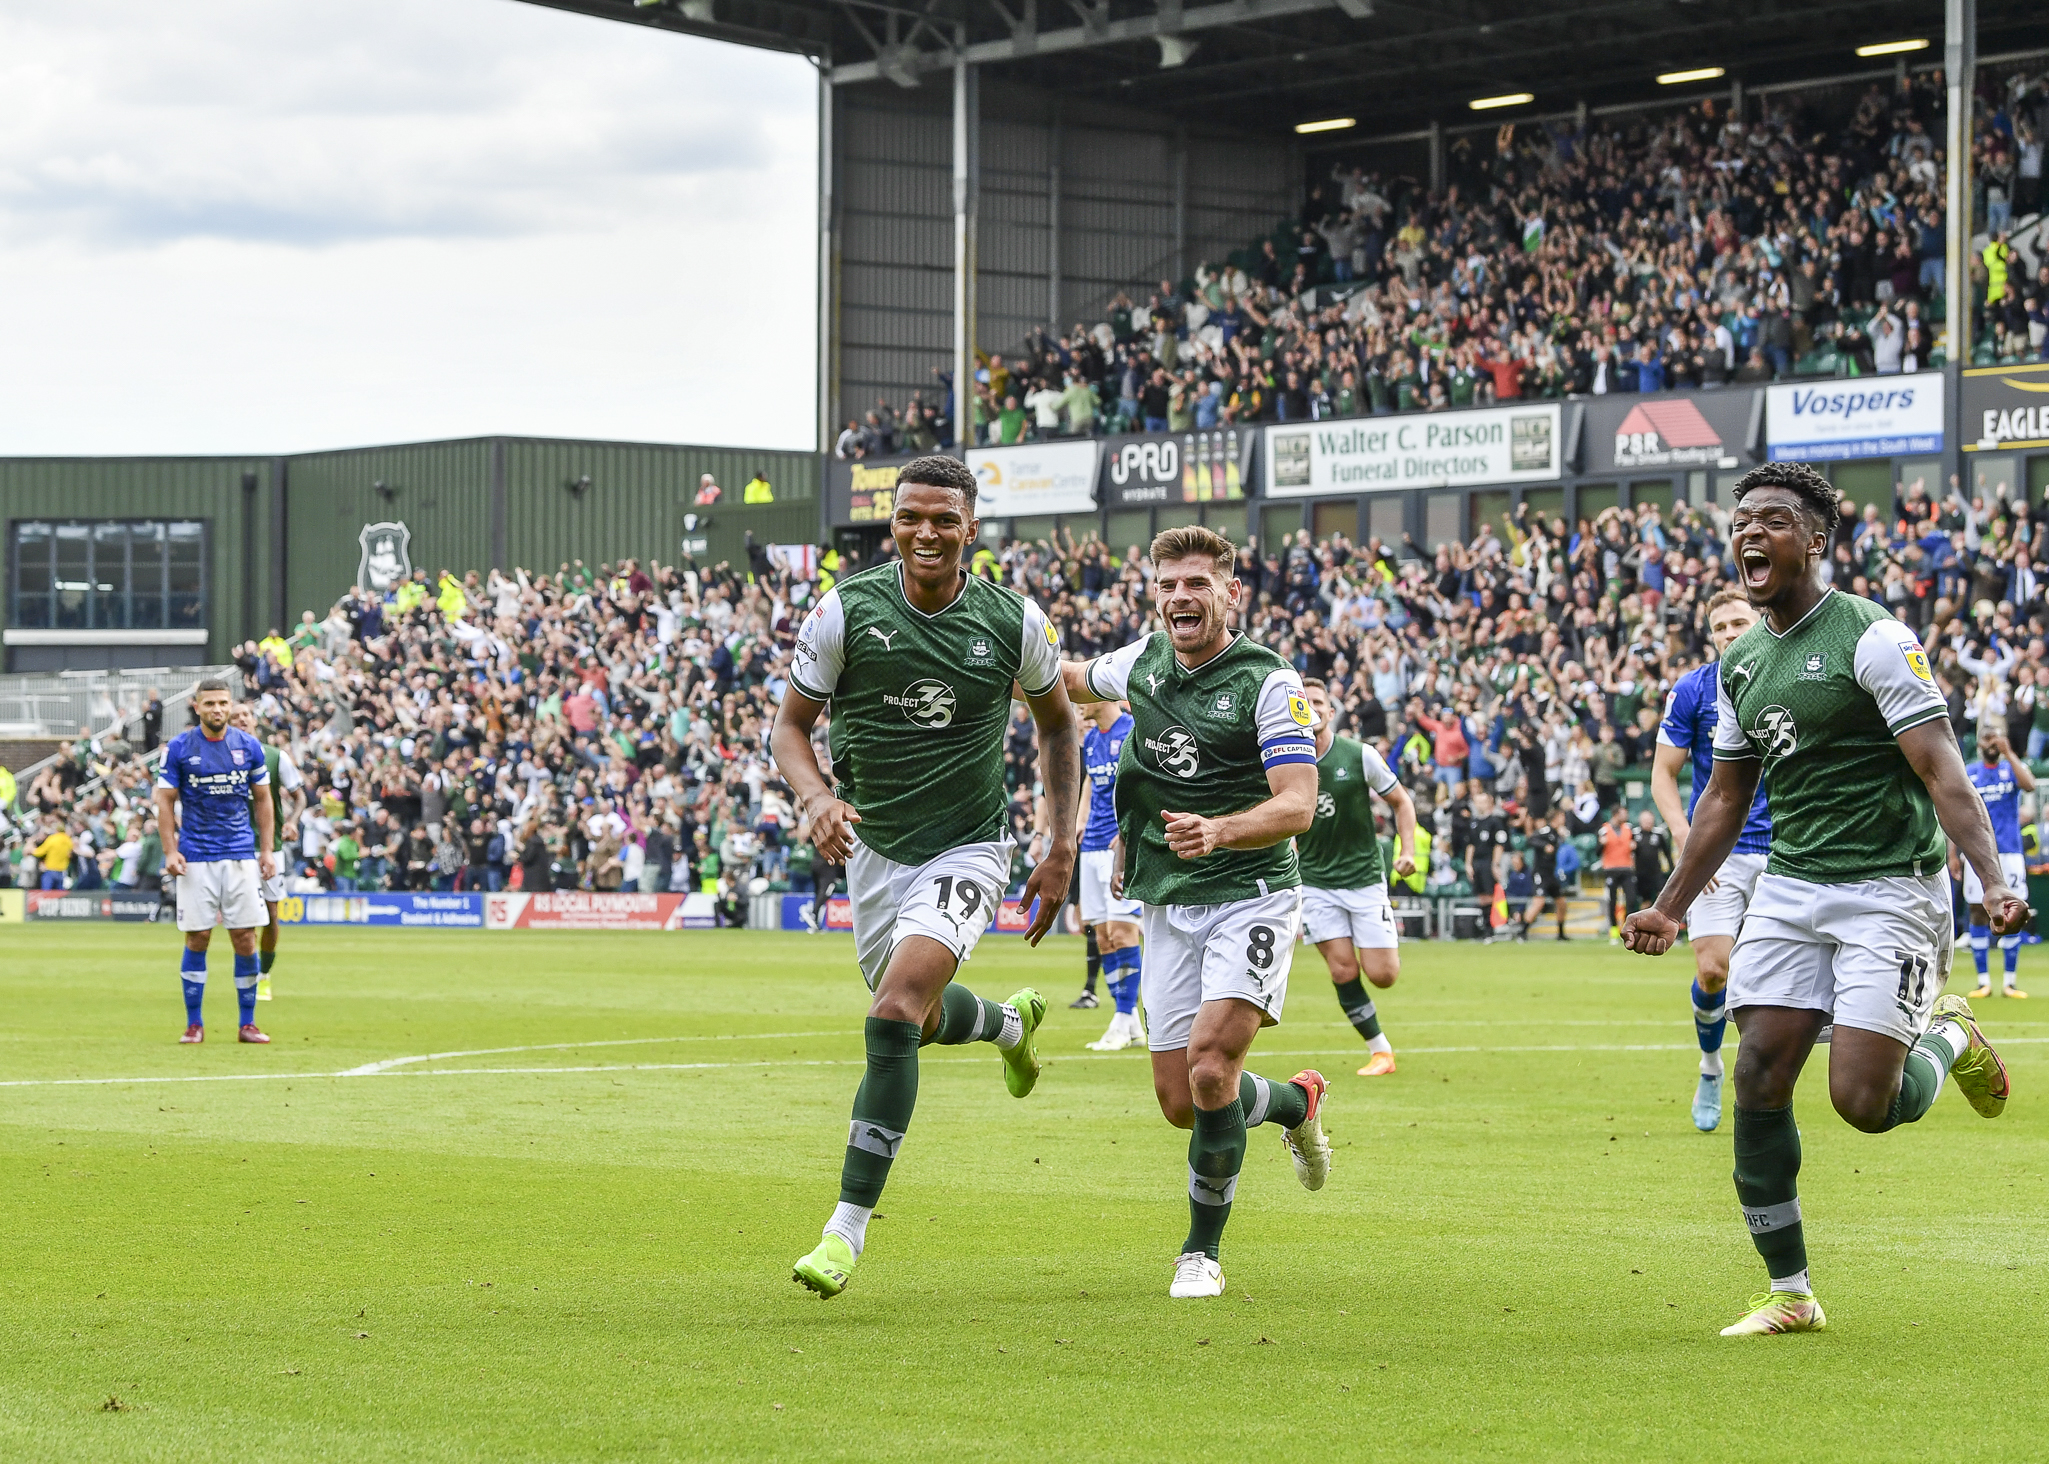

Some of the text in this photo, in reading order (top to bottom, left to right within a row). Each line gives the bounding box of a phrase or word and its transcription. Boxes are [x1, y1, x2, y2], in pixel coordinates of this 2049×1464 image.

[1793, 388, 1915, 418] Vospers
[1318, 421, 1503, 455] Walter C. Parson
[1983, 405, 2049, 441] EAGLE
[1615, 431, 1659, 455] PSR
[1332, 454, 1489, 484] Funeral Directors
[883, 694, 920, 708] PROJECT
[1145, 737, 1171, 754] PROJECT
[551, 893, 590, 913] LOCAL
[591, 893, 658, 912] PLYMOUTH
[933, 875, 982, 921] 19
[1246, 925, 1276, 969] 8
[1894, 950, 1929, 1008] 11
